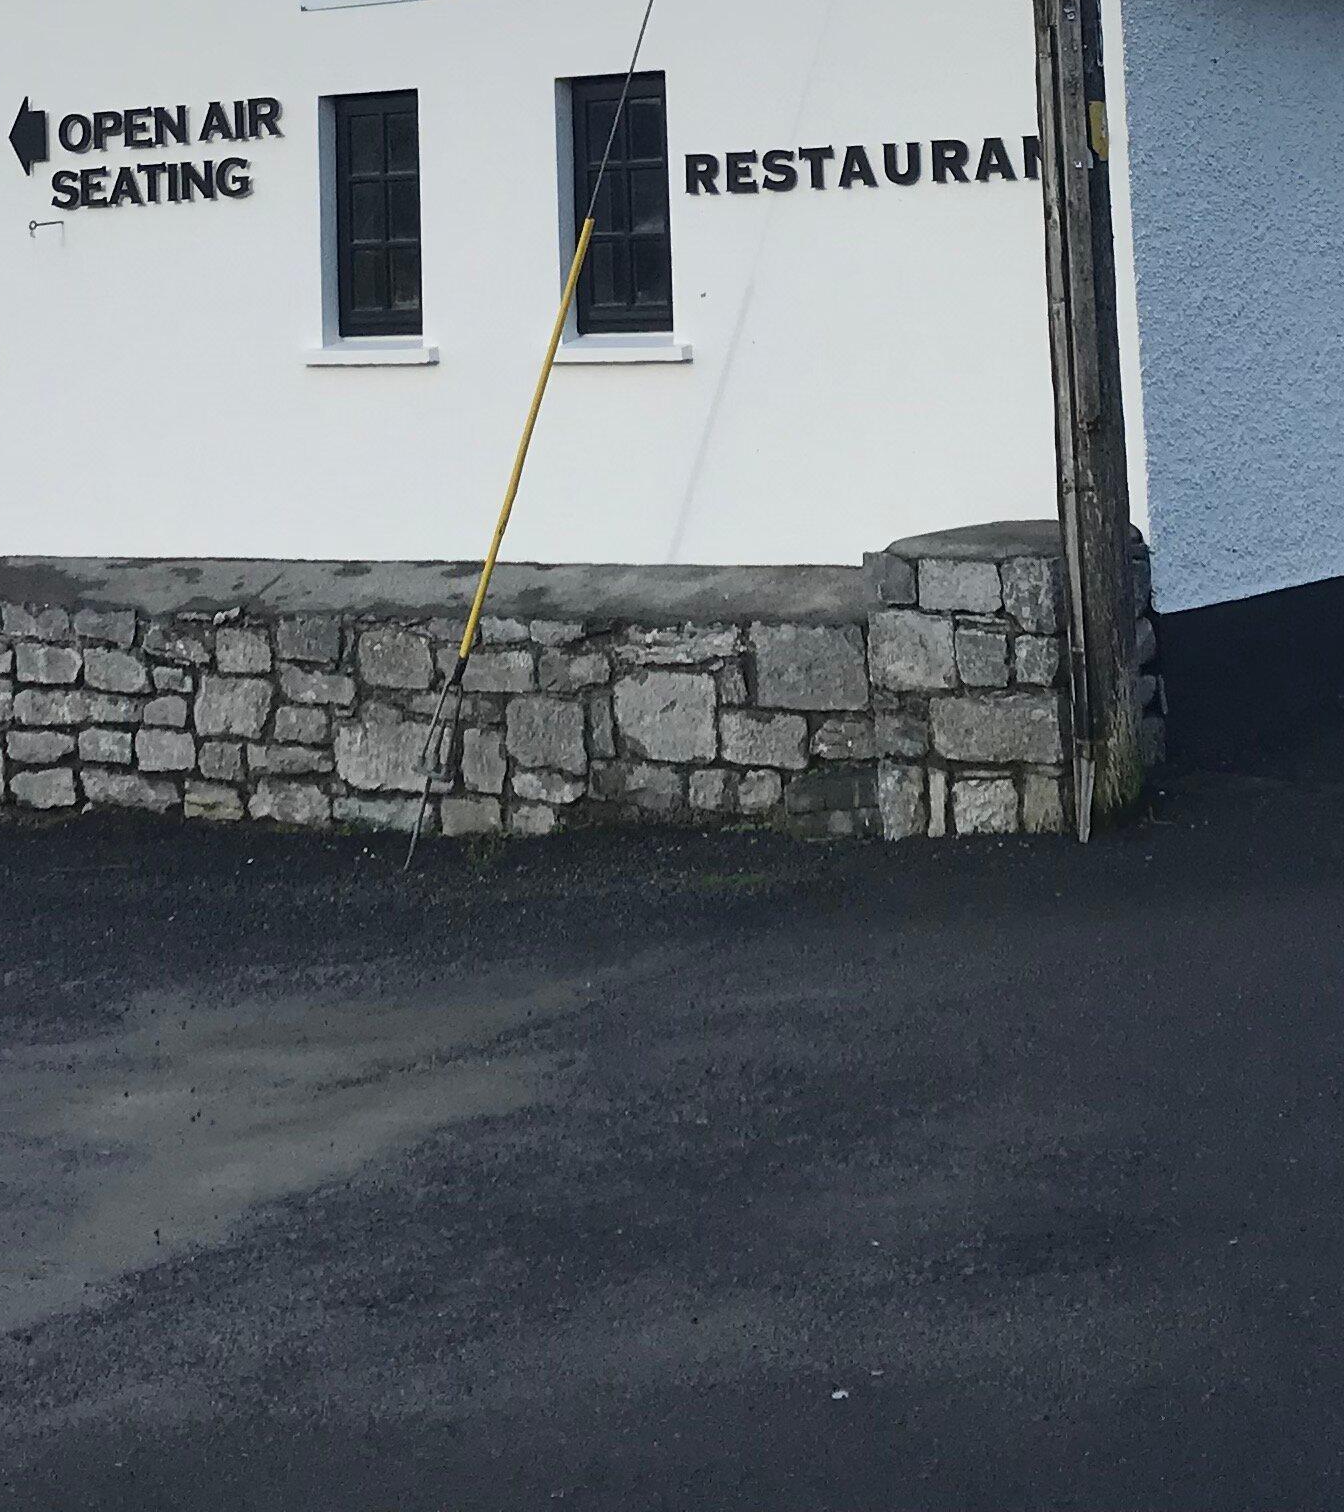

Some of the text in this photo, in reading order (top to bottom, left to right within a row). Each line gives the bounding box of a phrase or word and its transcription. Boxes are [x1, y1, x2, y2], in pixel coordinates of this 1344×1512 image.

[58, 97, 284, 152] OPEN AIR
[51, 157, 252, 210] SEATING
[684, 135, 1041, 194] RESTAURAN
